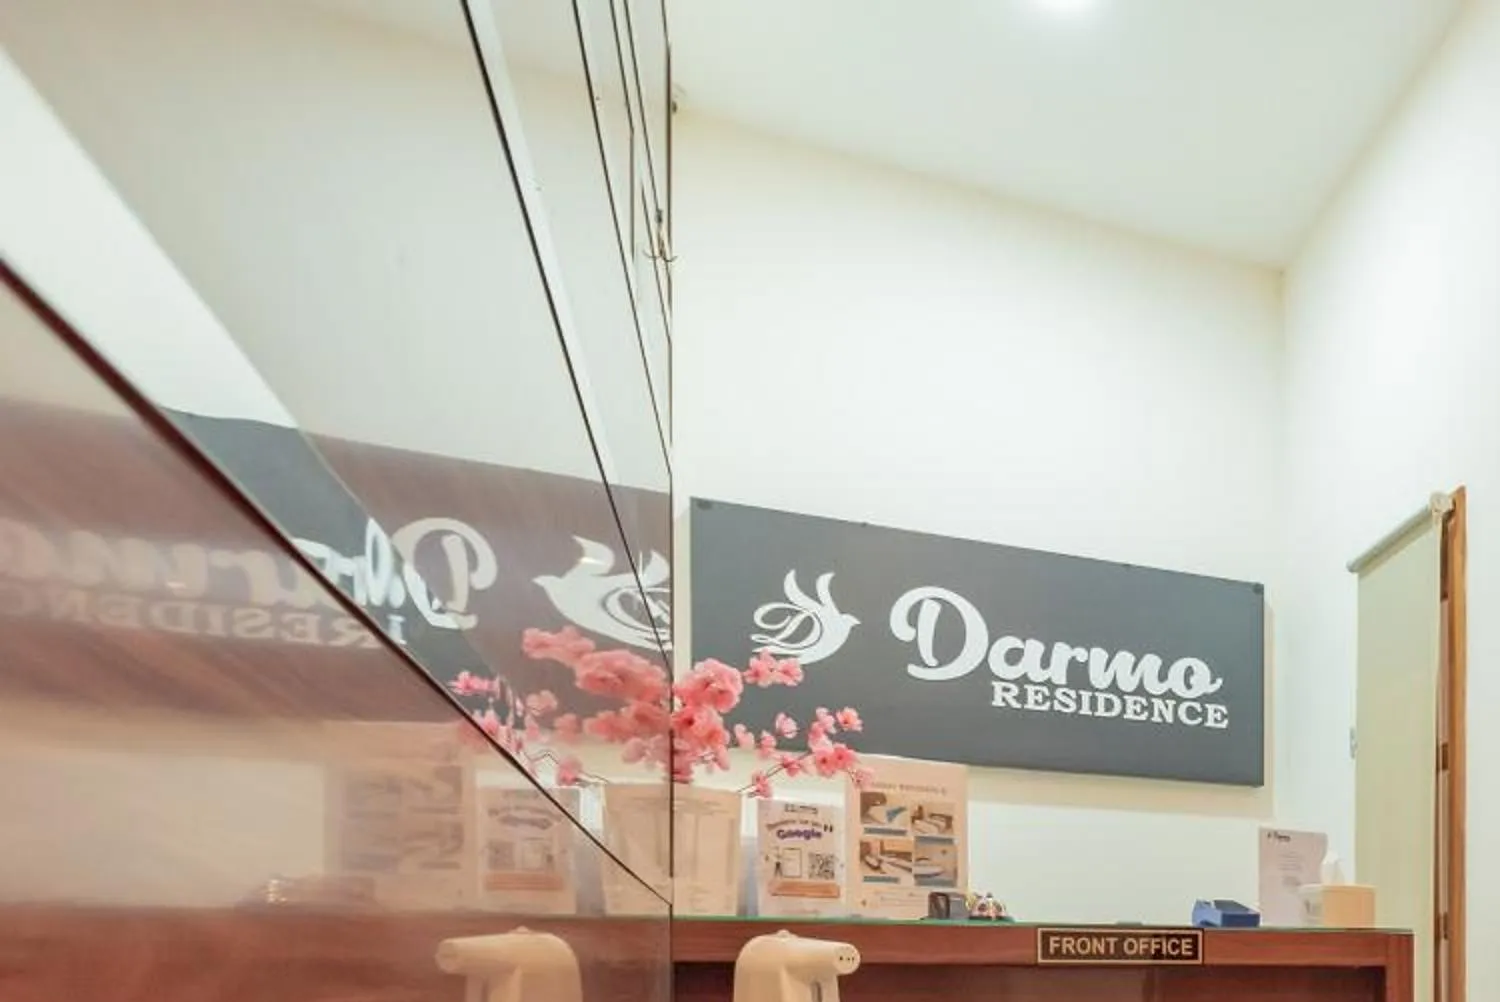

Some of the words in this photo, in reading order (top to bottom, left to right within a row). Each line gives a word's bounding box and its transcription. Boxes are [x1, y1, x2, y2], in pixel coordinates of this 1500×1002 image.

[889, 585, 1222, 699] Darmo
[991, 681, 1229, 729] RESIDENCE
[1049, 936, 1118, 955] FRONT
[1123, 938, 1193, 956] OFFICE
